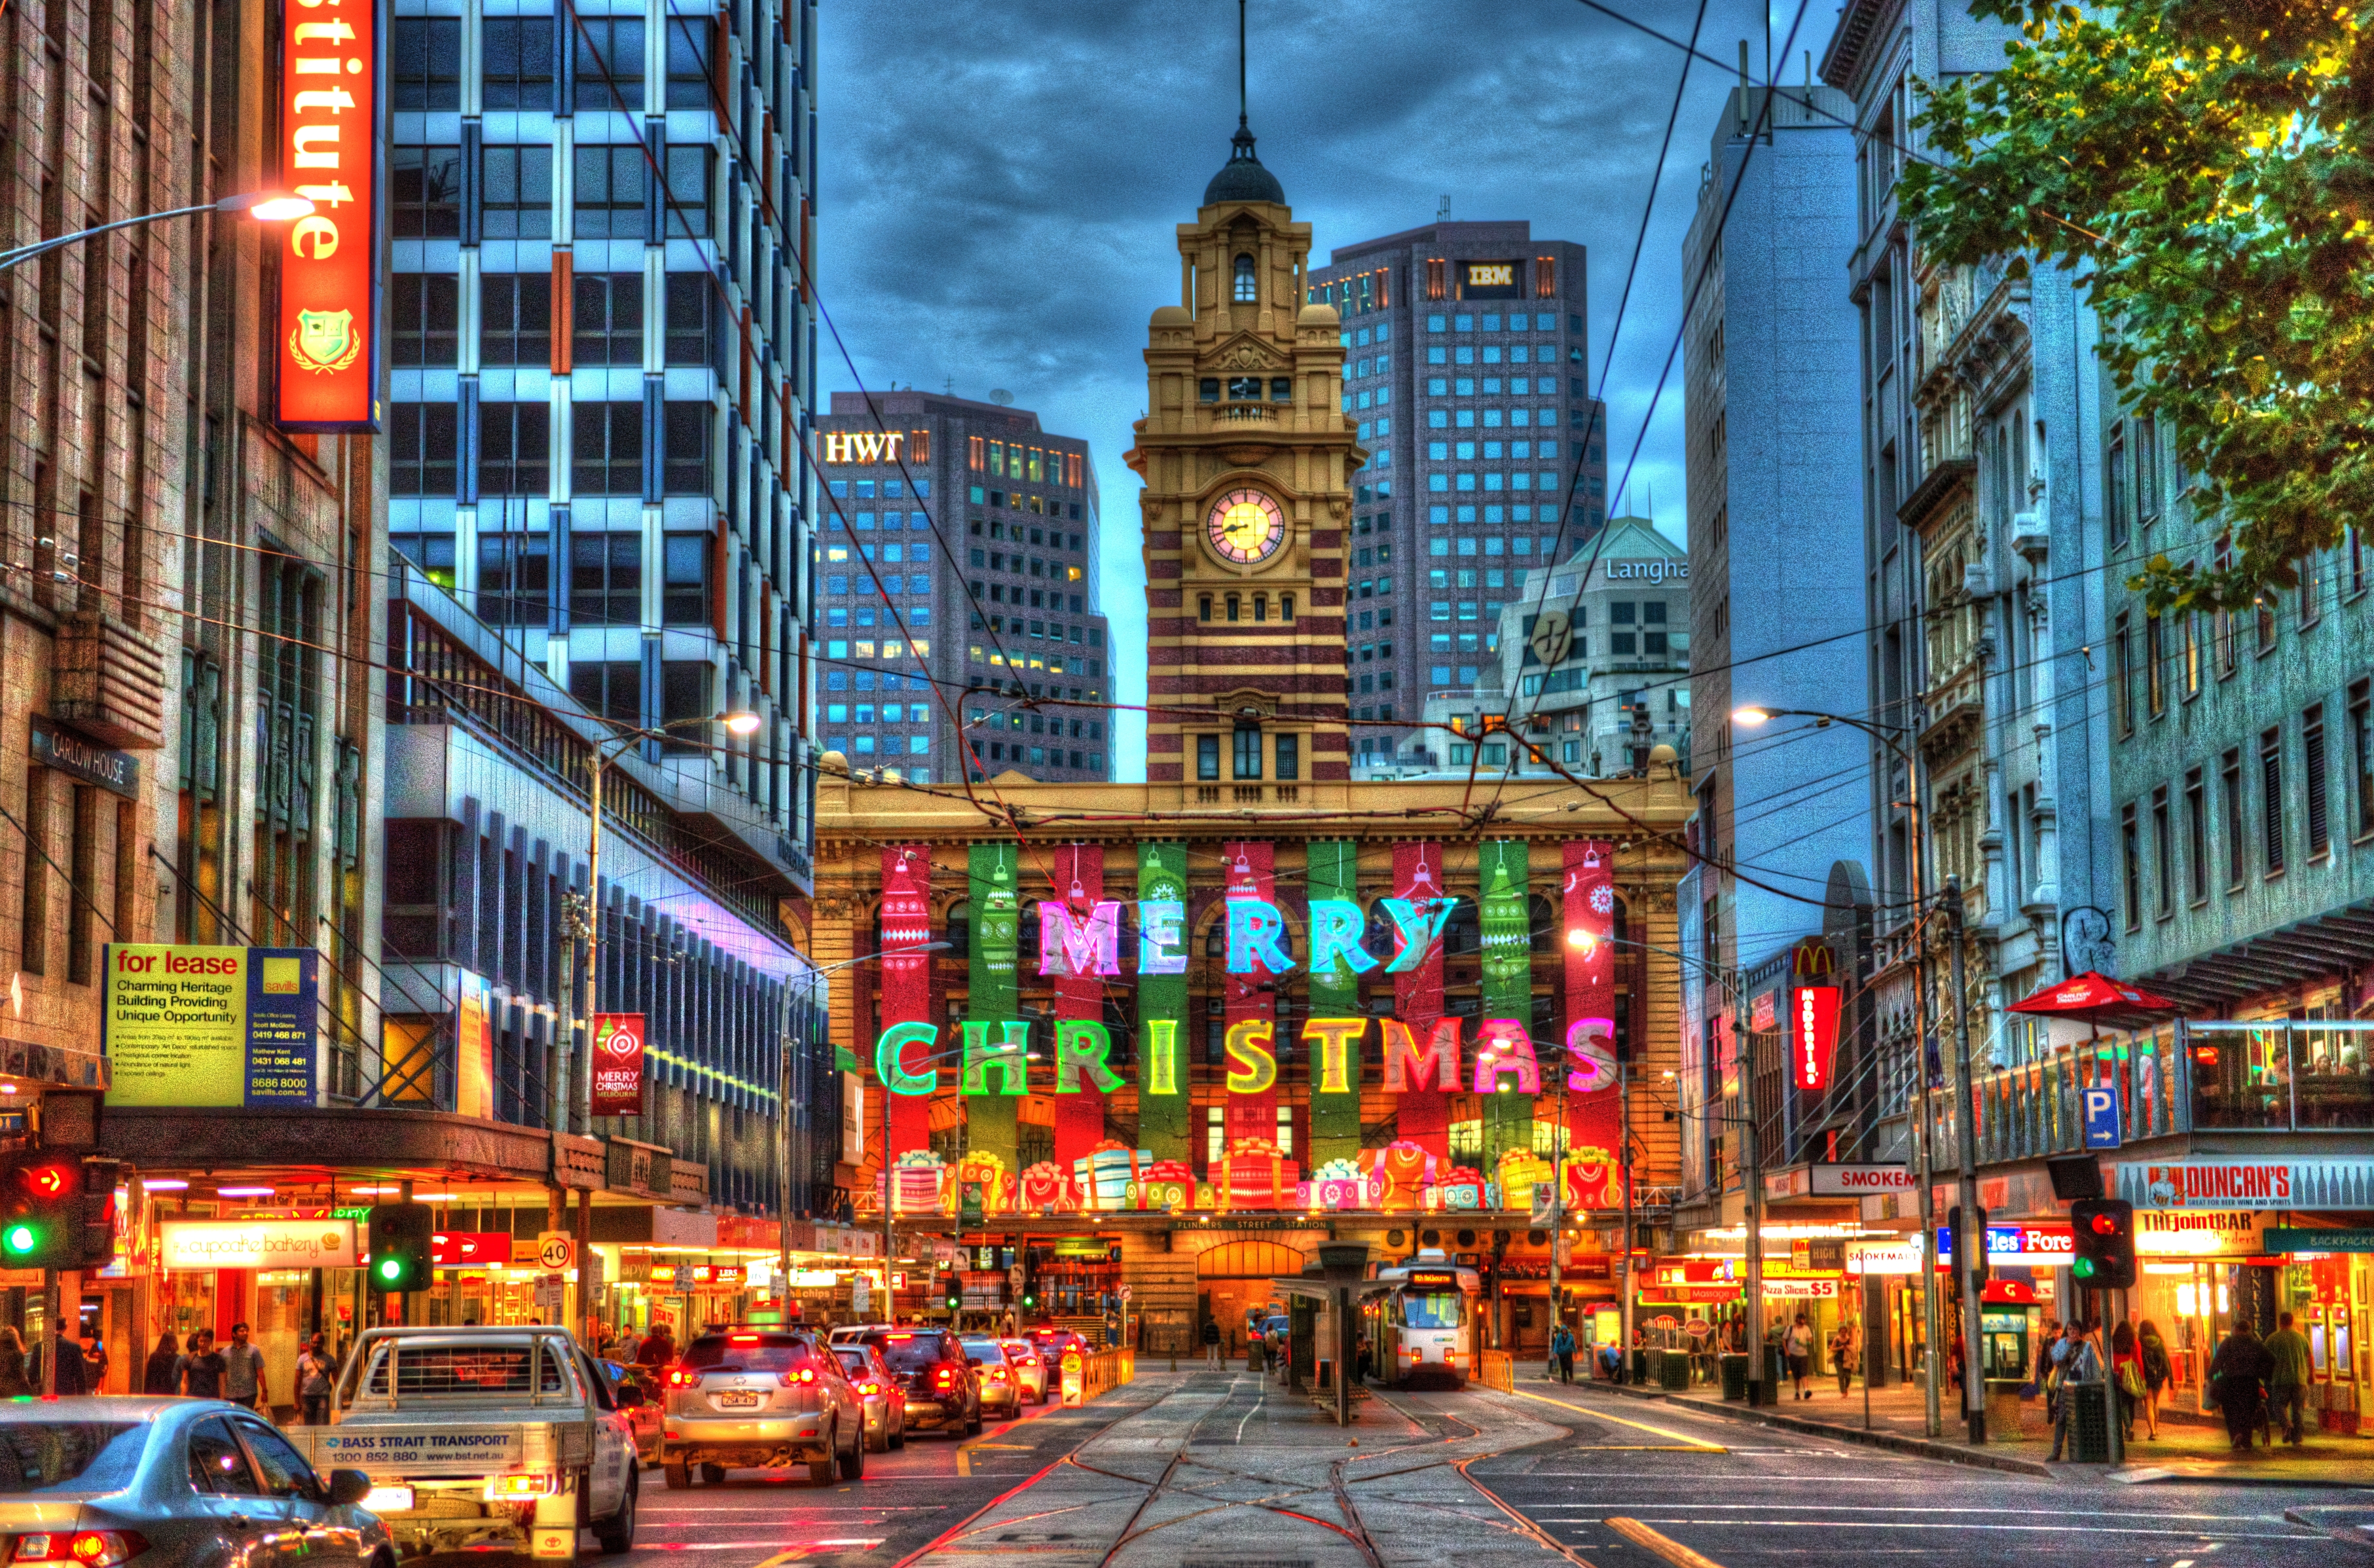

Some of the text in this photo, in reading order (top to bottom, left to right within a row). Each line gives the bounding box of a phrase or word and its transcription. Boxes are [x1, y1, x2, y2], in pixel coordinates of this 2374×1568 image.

[1469, 266, 1512, 285] IBM
[826, 433, 904, 462] HWT
[1607, 558, 1689, 585] Langha
[52, 732, 124, 784] CARLOW HOUSE
[1038, 898, 1459, 976] MERRY
[117, 950, 238, 975] for lease
[117, 980, 232, 994] Charming Heritage
[265, 981, 298, 992] savills
[117, 995, 227, 1010] Building Providing
[117, 1010, 237, 1025] Unique Opportunity
[1802, 989, 1819, 1085] McDonald's
[875, 1017, 1618, 1096] CHRISTMAS
[252, 1078, 307, 1088] 8686 8000
[597, 1071, 639, 1082] MERRY
[251, 1088, 307, 1097] savills.com.au
[596, 1082, 638, 1091] CHRISTMAS
[2087, 1092, 2111, 1123] P
[2186, 1166, 2290, 1198] DUNCAN'S
[189, 1234, 261, 1260] cupcake
[263, 1233, 320, 1259] bakery
[543, 1245, 567, 1261] 40
[1812, 1247, 1836, 1260] HIGH
[709, 1287, 732, 1296] Repairs
[1692, 1289, 1730, 1299] Massage
[1761, 1281, 1833, 1296] Pizza Slices $5
[342, 1434, 509, 1448] BASS STRAIT TRANSPORT
[333, 1450, 504, 1463] 1300 852 880 www.bst.net.au
